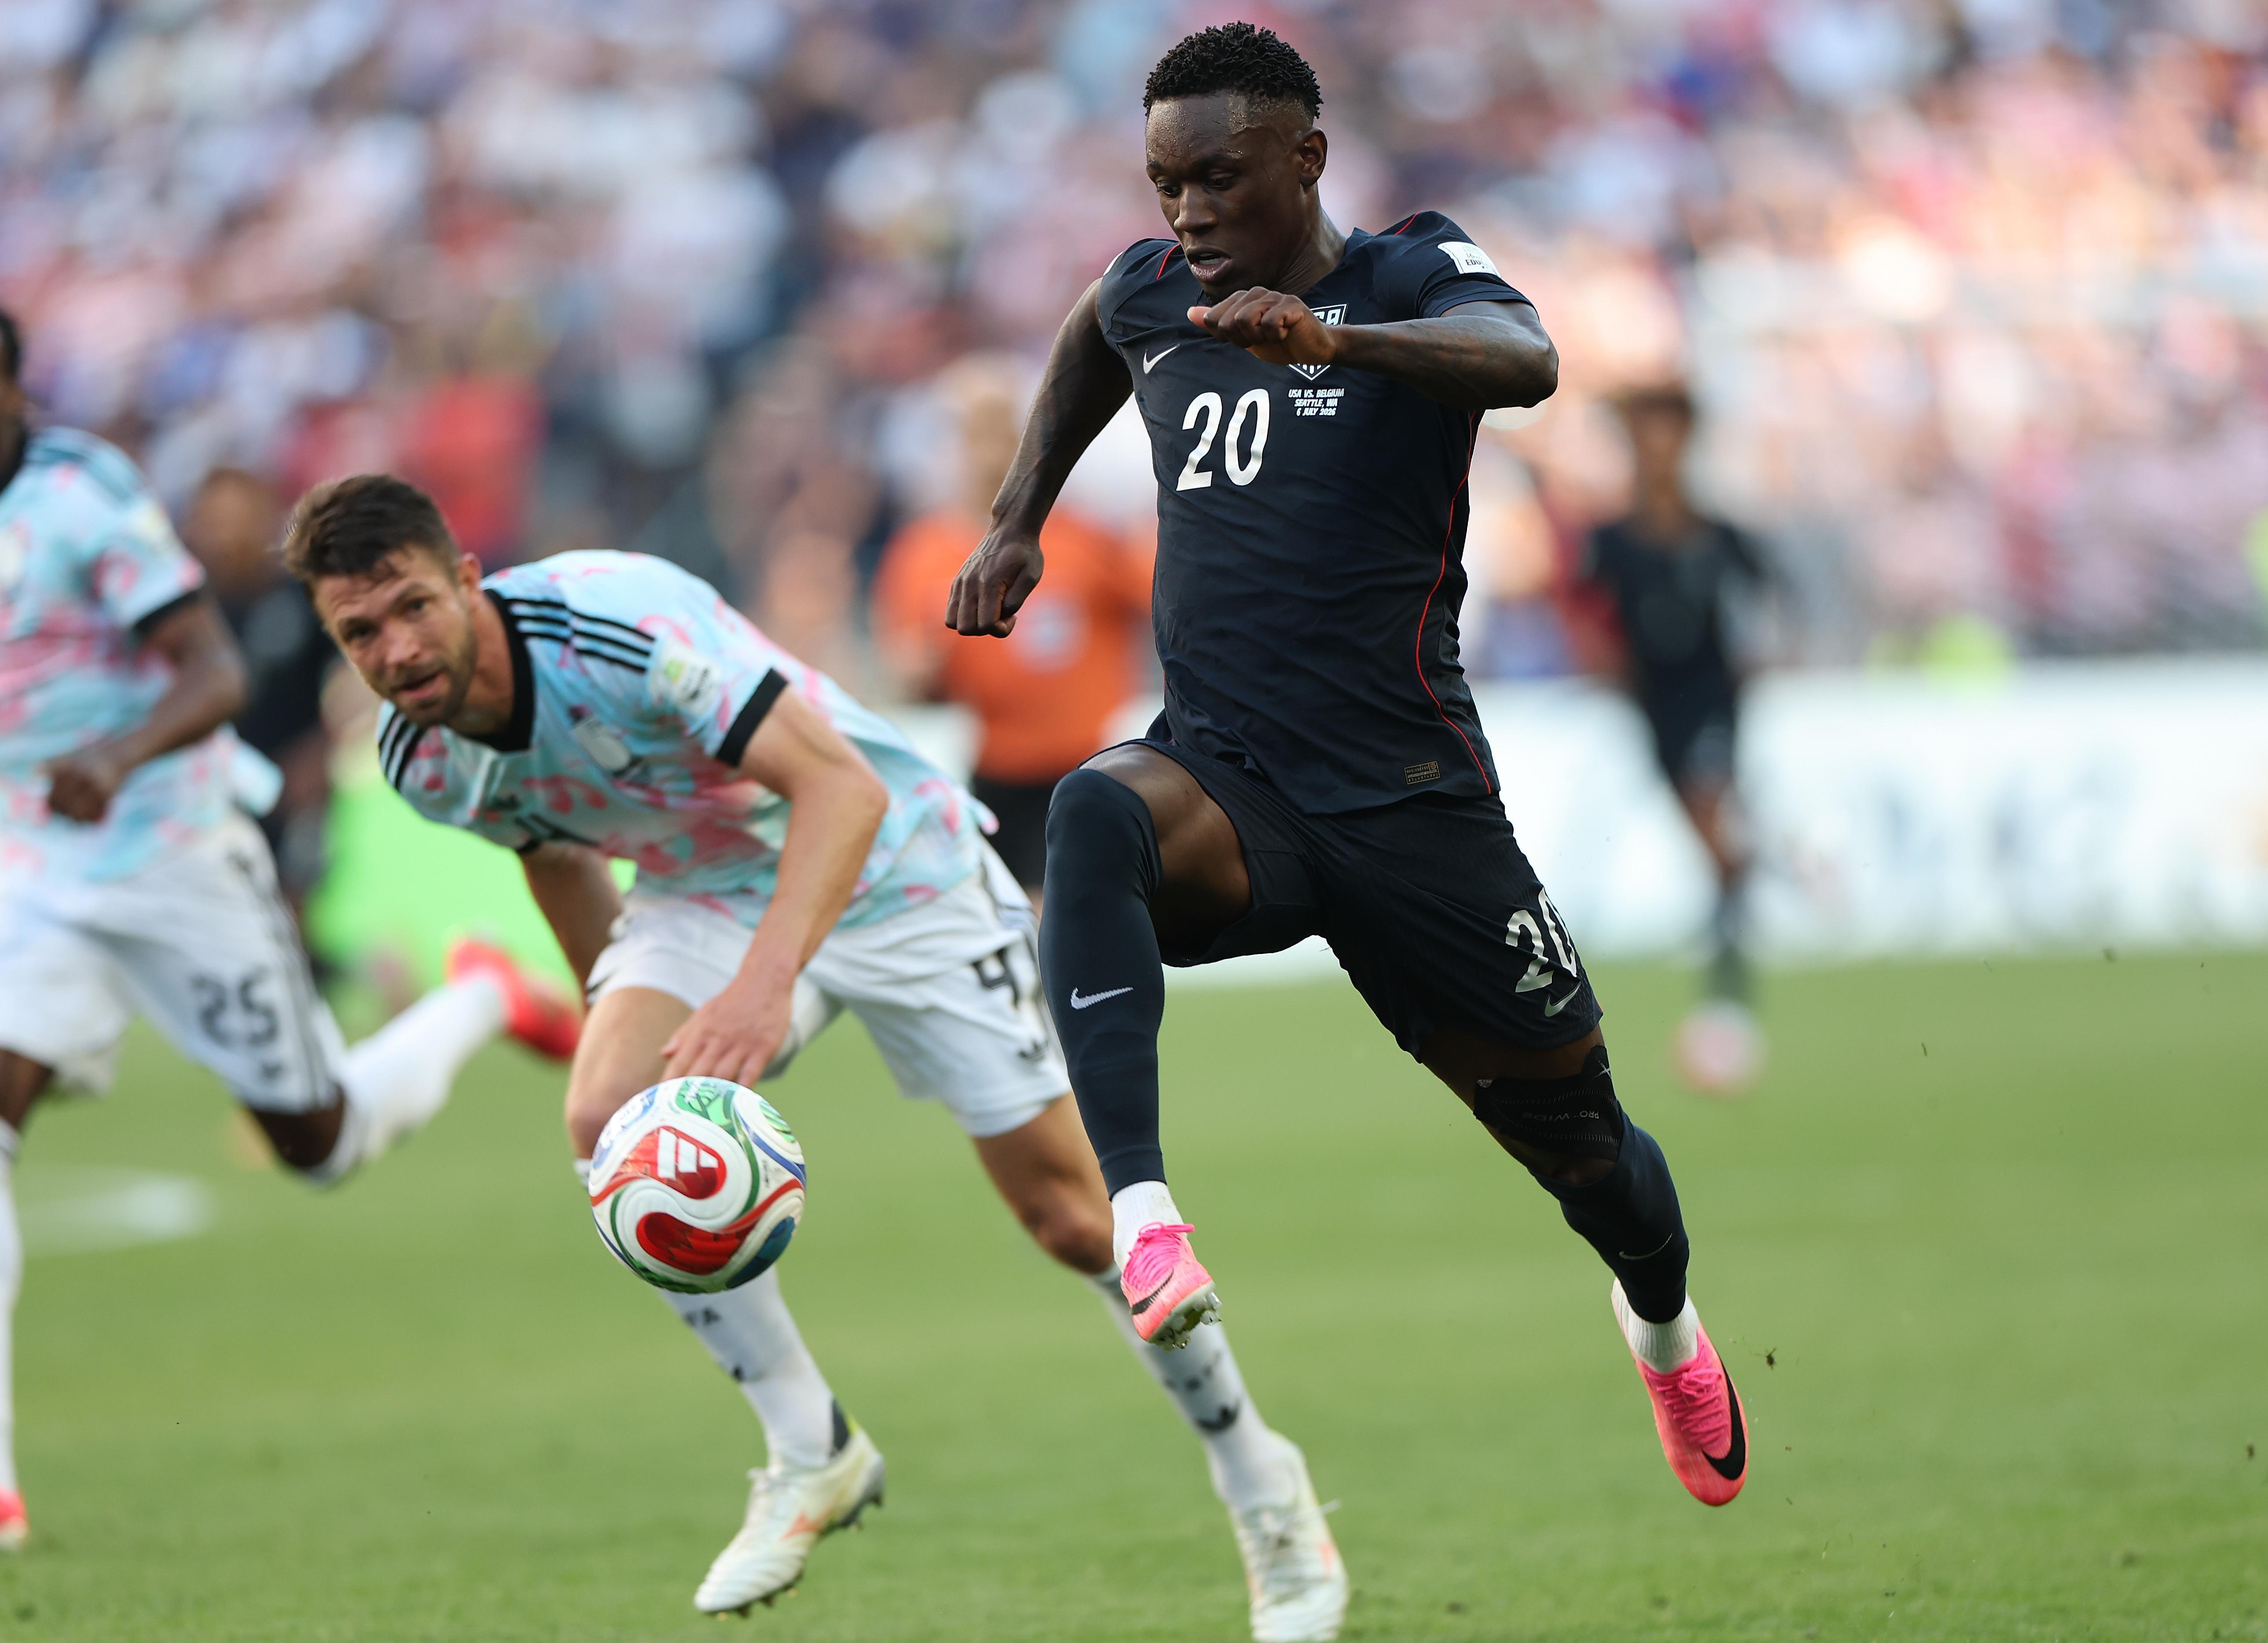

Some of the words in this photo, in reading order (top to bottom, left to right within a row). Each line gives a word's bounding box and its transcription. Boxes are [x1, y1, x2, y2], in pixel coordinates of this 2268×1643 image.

[1288, 389, 1302, 398] USA
[1304, 389, 1314, 398] VS.
[1316, 388, 1345, 398] BELGIUM
[1294, 399, 1324, 408] SEATTLE,
[1326, 398, 1338, 407] WA
[1296, 408, 1302, 416] 6
[1302, 408, 1319, 416] JULY
[1176, 388, 1269, 491] 20
[1506, 887, 1577, 993] 20
[188, 964, 280, 1050] 25
[1579, 1110, 1599, 1119] PRO
